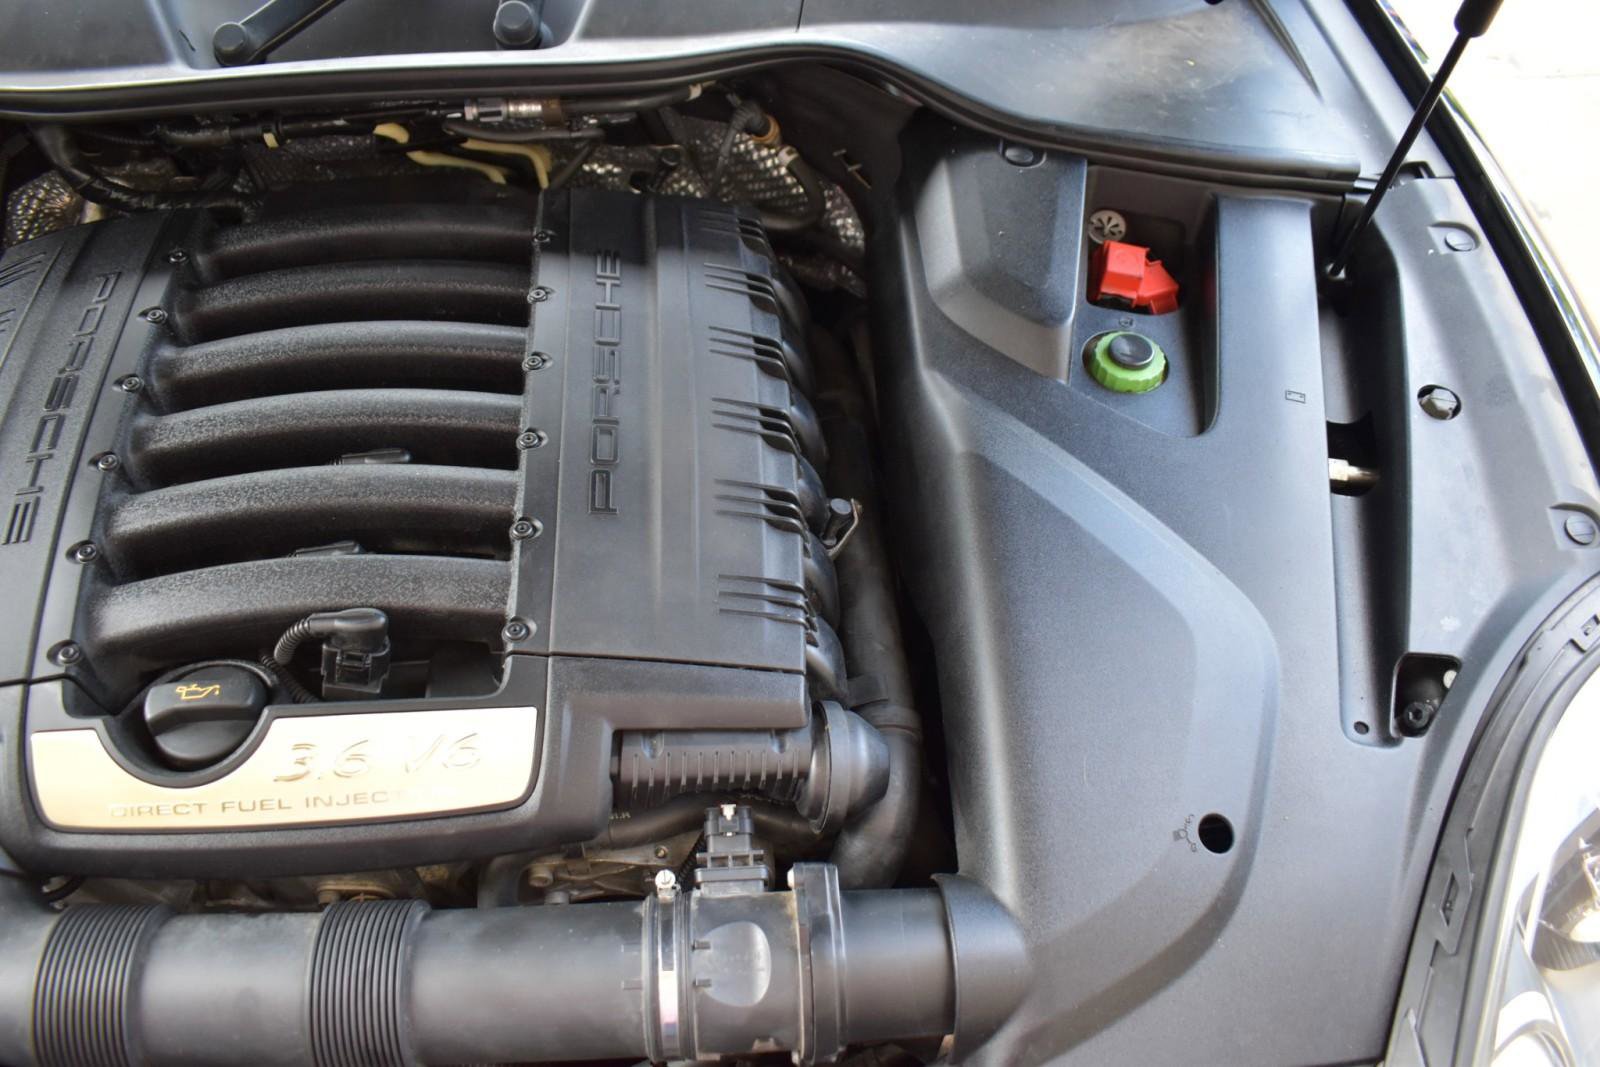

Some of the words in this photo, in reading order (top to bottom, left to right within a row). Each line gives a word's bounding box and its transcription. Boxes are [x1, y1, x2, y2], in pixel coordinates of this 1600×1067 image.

[2, 271, 122, 546] PORSCHE
[588, 250, 622, 515] PORSCHE
[110, 801, 209, 819] DIRECT
[221, 796, 292, 814] FUEL
[272, 737, 371, 784] 3.6
